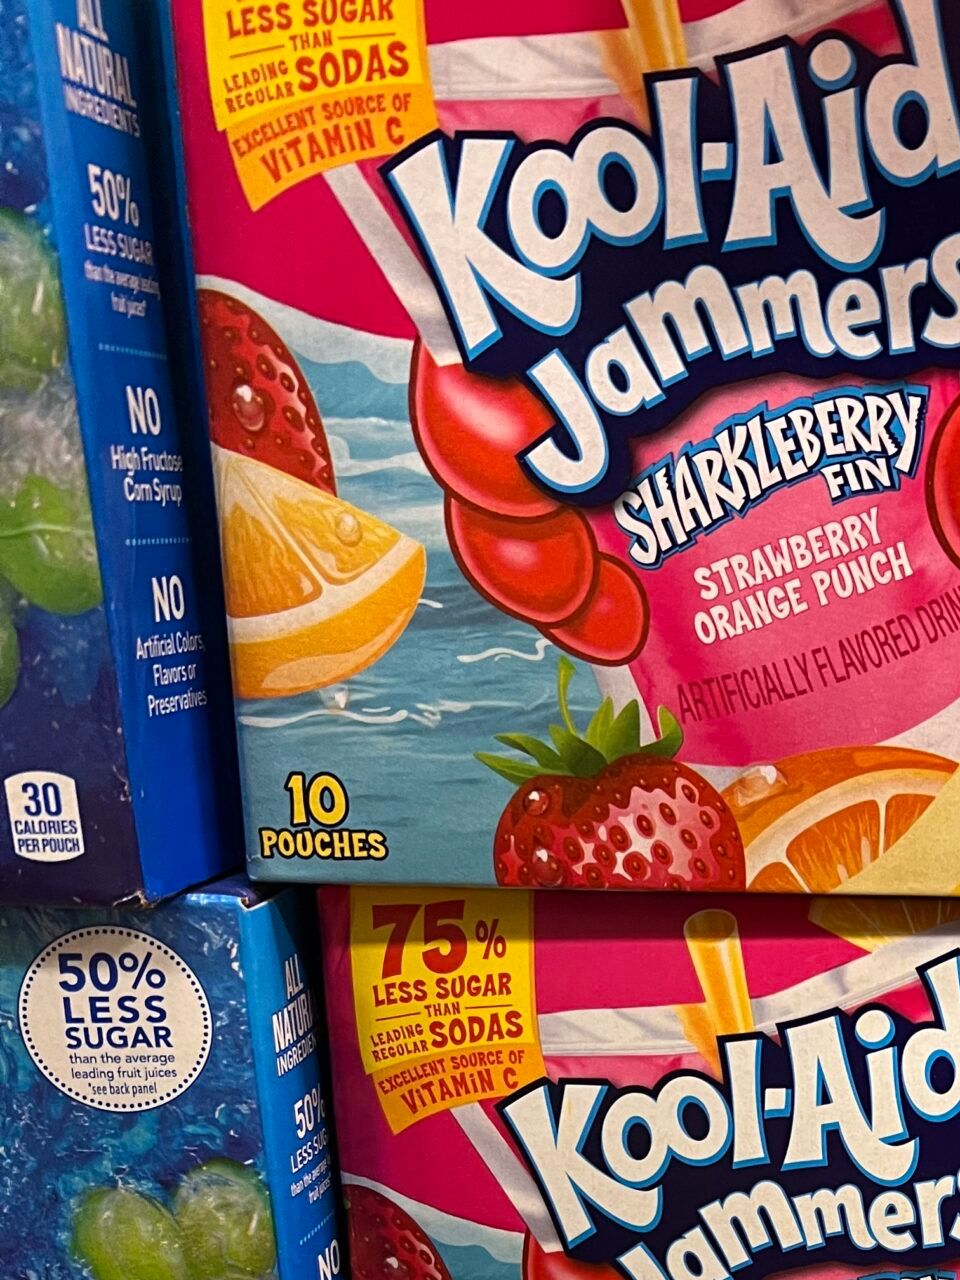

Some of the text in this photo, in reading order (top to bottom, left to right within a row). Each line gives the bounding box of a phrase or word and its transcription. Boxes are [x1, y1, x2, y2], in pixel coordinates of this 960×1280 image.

[303, 0, 394, 27] SUGAR
[290, 30, 333, 52] THAN
[56, 23, 137, 107] NATURAL
[298, 40, 409, 93] SODAS
[87, 163, 139, 227] 50%
[117, 233, 153, 266] SUGAR
[126, 385, 161, 435] NO
[111, 445, 182, 476] High Fructose
[124, 479, 182, 507] Corn Syrup
[614, 391, 923, 564] SHARKLEBERRY
[825, 457, 891, 500] FIN
[694, 507, 883, 600] STRAWBERRY
[151, 576, 184, 622] NO
[694, 542, 914, 645] ORANGE PUNCH
[136, 635, 175, 660] Artificial
[153, 662, 187, 686] Flavors
[677, 653, 814, 724] ARTIFICIALLY
[815, 613, 921, 690] FLAVORED
[148, 689, 207, 718] Preservatives
[21, 782, 62, 816] 30
[286, 773, 347, 824] 10
[14, 820, 77, 835] CALORIES
[17, 837, 80, 853] PER POUCH
[261, 830, 387, 859] POUCHES
[58, 952, 166, 992] 50%
[284, 954, 303, 996] ALL
[373, 972, 512, 1007] LESS SUGAR
[64, 996, 167, 1024] LESS
[424, 1002, 460, 1017] THAN
[66, 1026, 173, 1049] SUGAR
[431, 1010, 523, 1048] SODAS
[69, 1052, 175, 1067] than average
[71, 1068, 114, 1081] leading
[111, 1082, 158, 1097] back panel
